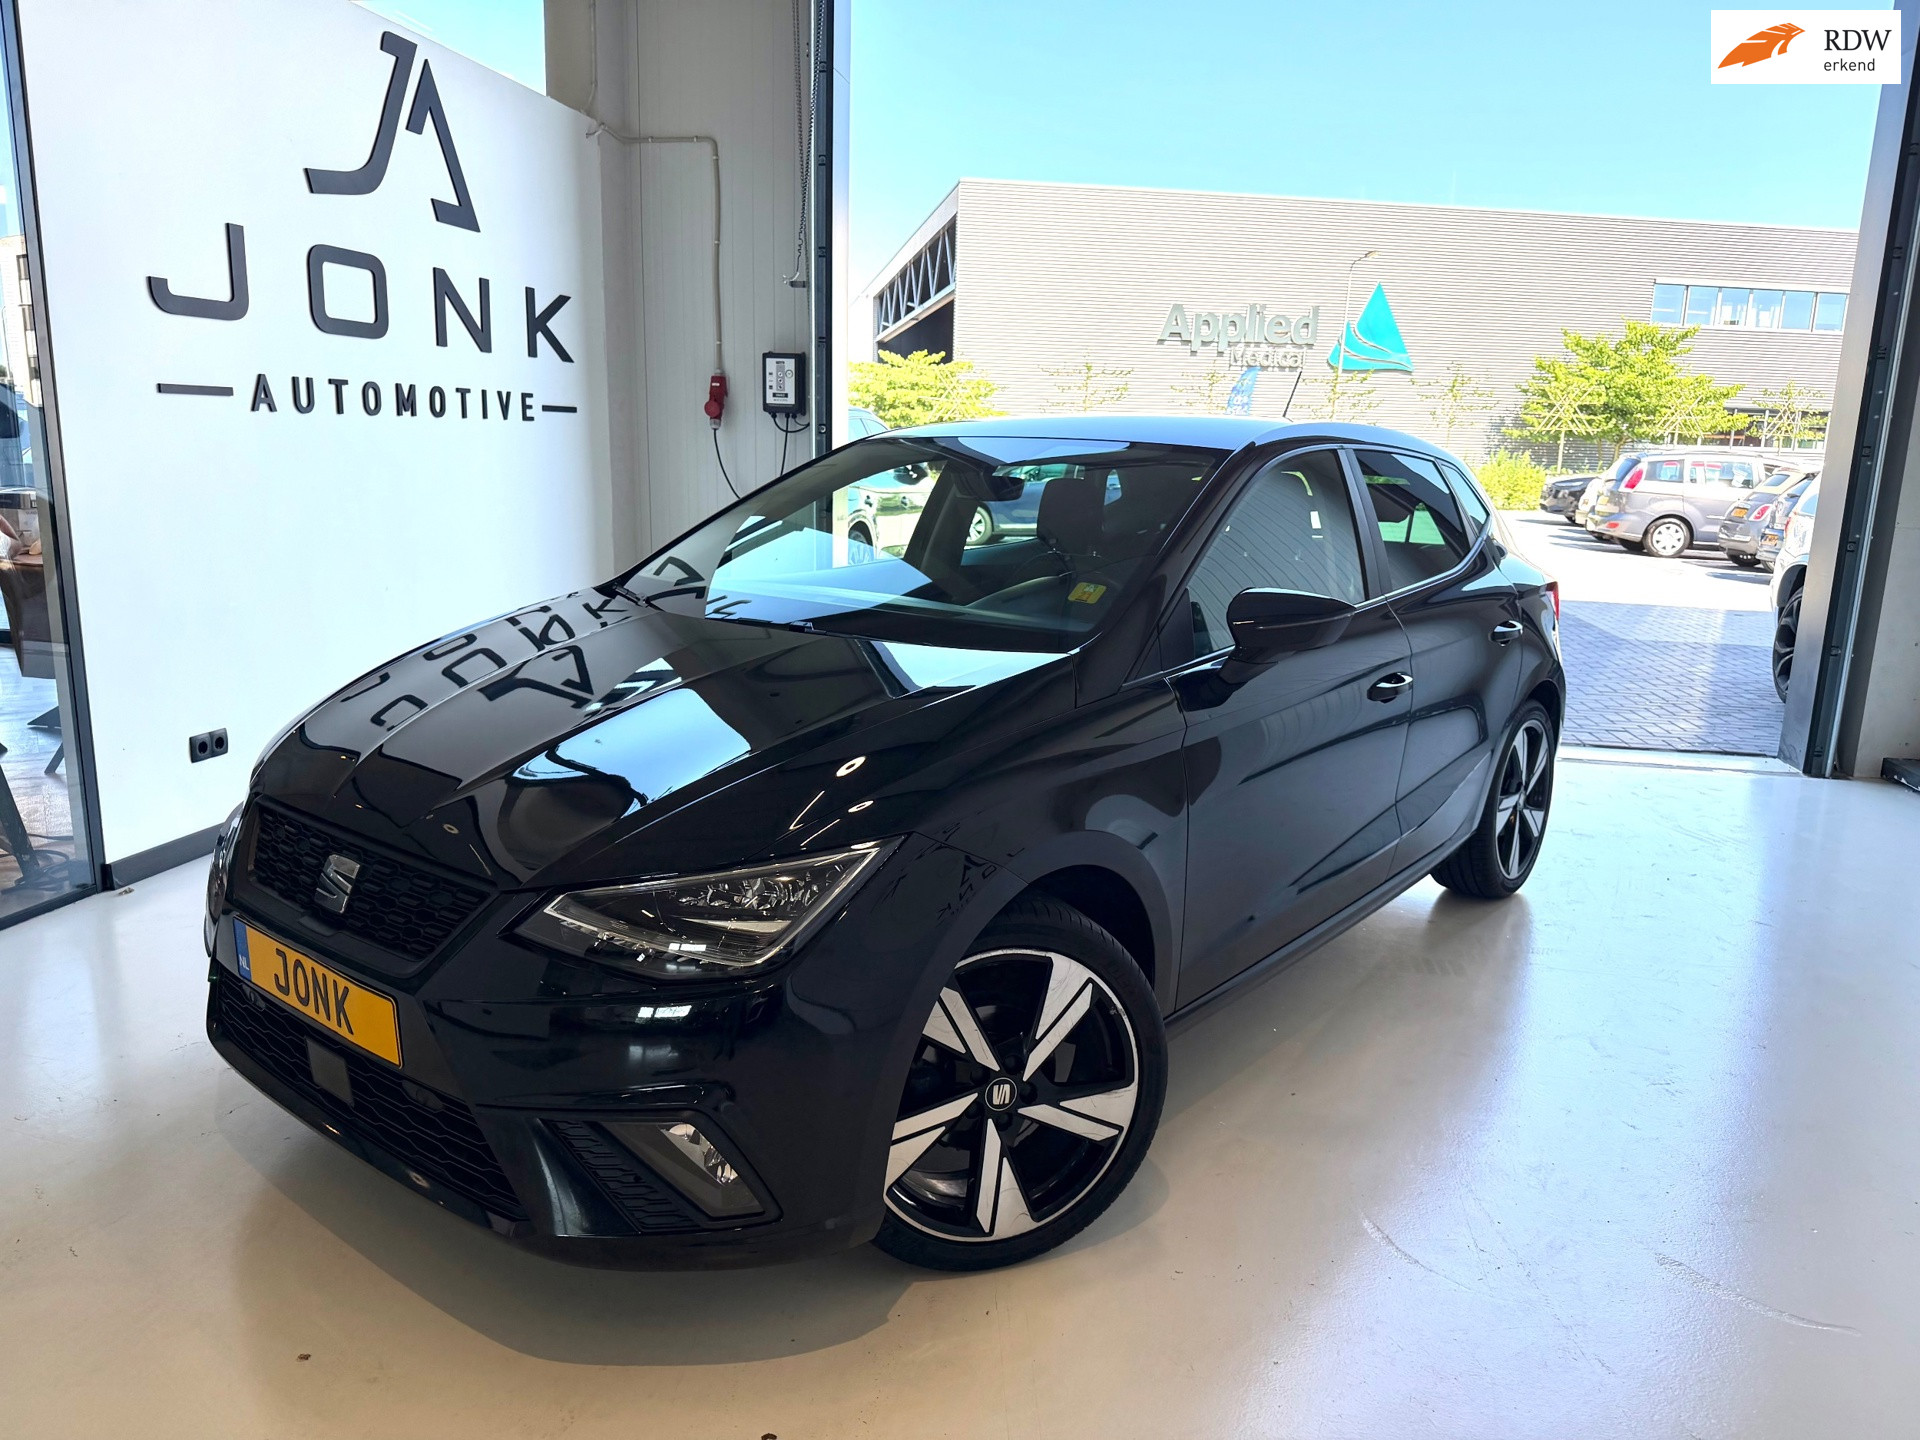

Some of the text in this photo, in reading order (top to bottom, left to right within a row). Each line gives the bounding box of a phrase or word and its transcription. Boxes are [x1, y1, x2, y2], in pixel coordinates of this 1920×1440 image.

[147, 222, 575, 363] JONK
[1157, 302, 1320, 354] Applied
[1230, 344, 1307, 368] Medical
[251, 372, 536, 422] AUTOMOTIVE
[238, 947, 355, 1036] NL JONK
